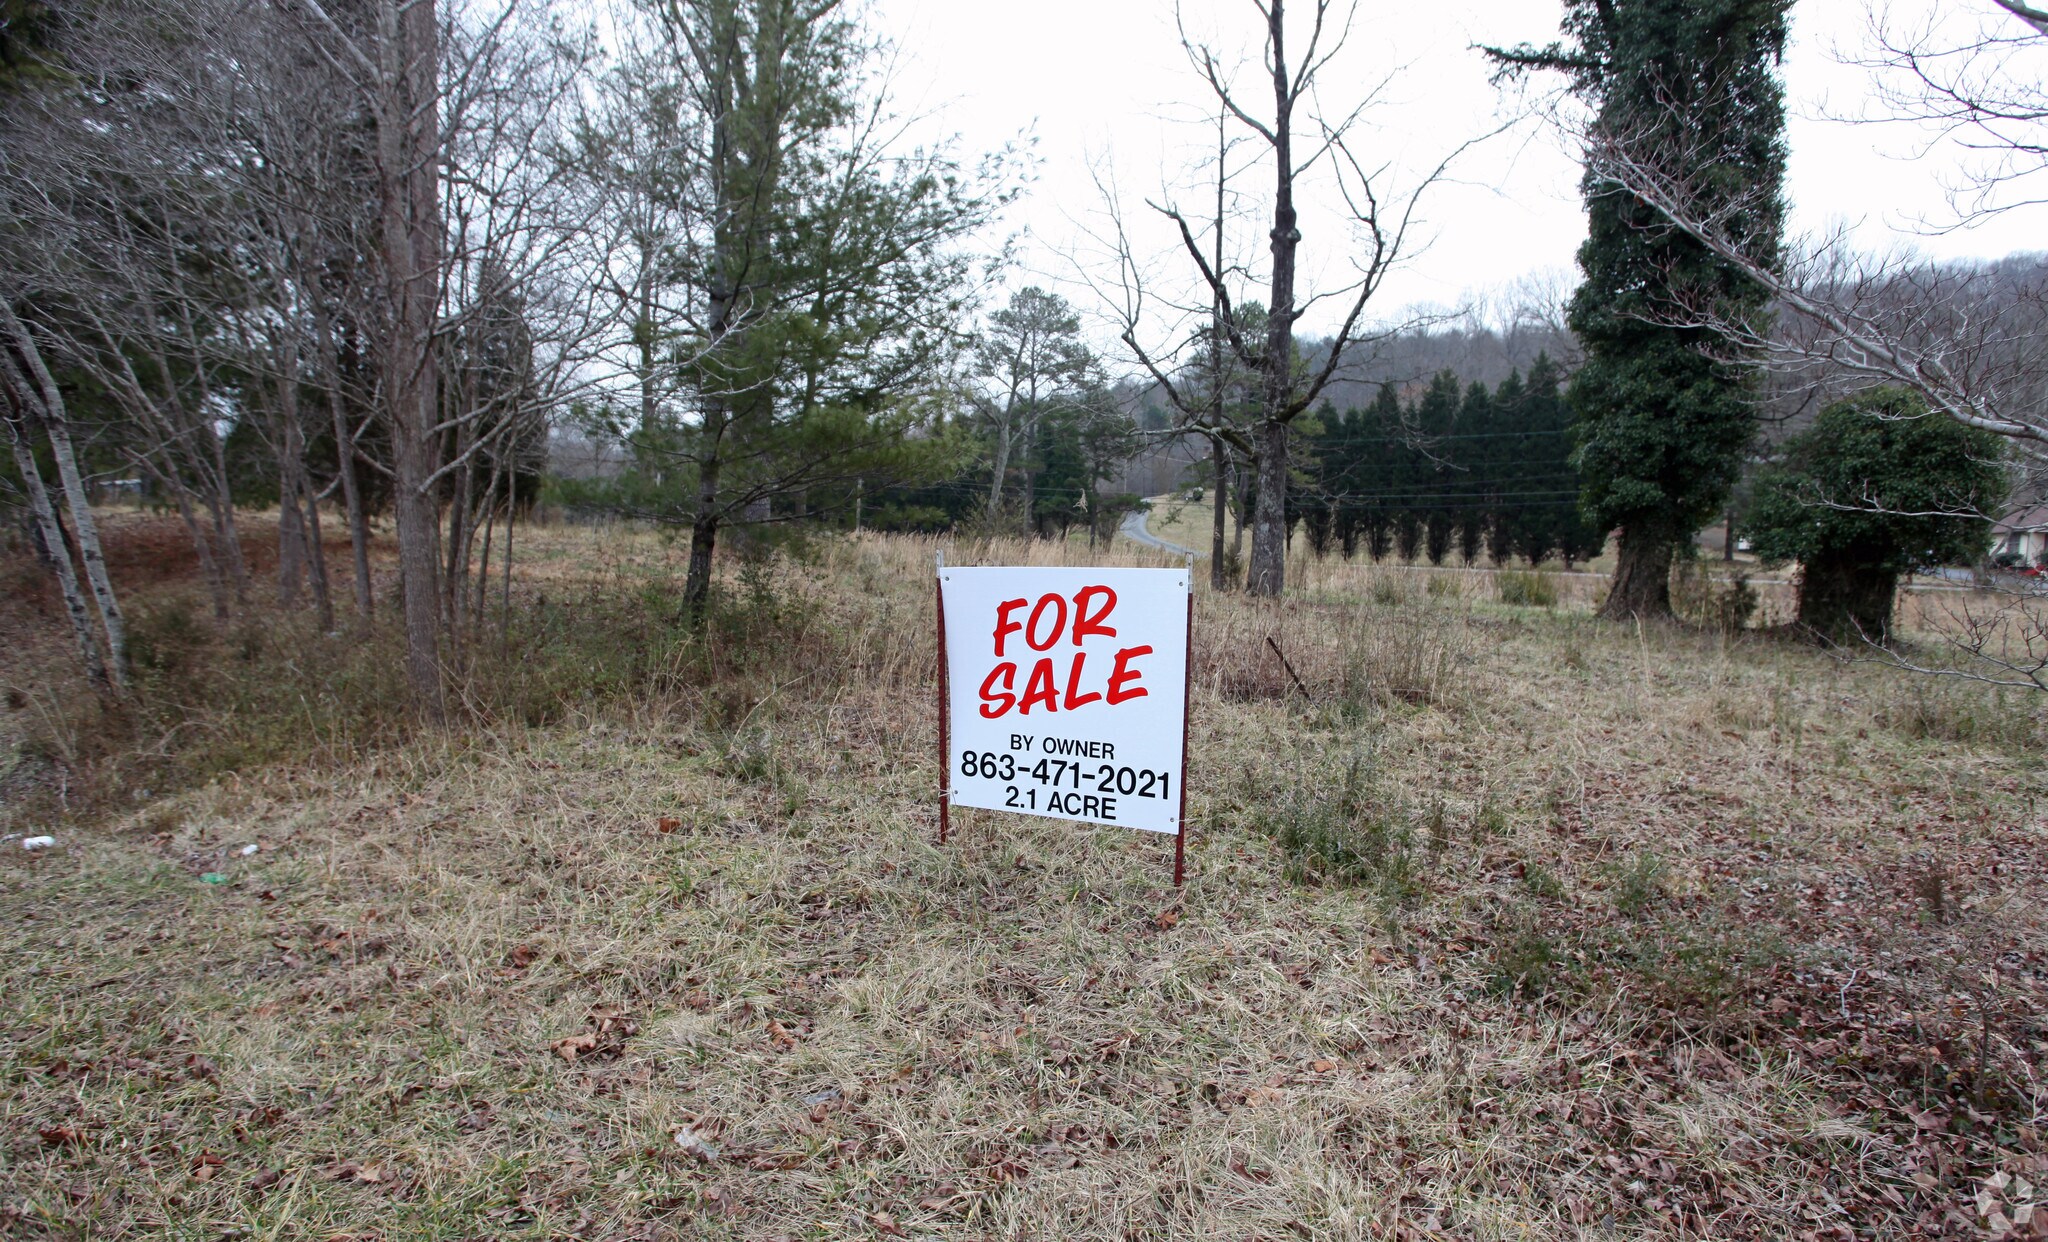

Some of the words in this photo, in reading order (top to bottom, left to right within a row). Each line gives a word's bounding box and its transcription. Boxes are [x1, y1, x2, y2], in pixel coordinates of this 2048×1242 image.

[993, 585, 1118, 657] FOR
[978, 645, 1153, 719] SALE
[1010, 734, 1034, 751] BY
[1043, 737, 1114, 759] OWNER
[961, 751, 1169, 800] 863-471-2021
[1006, 786, 1035, 809] 2.1
[1047, 792, 1116, 820] ACRE
